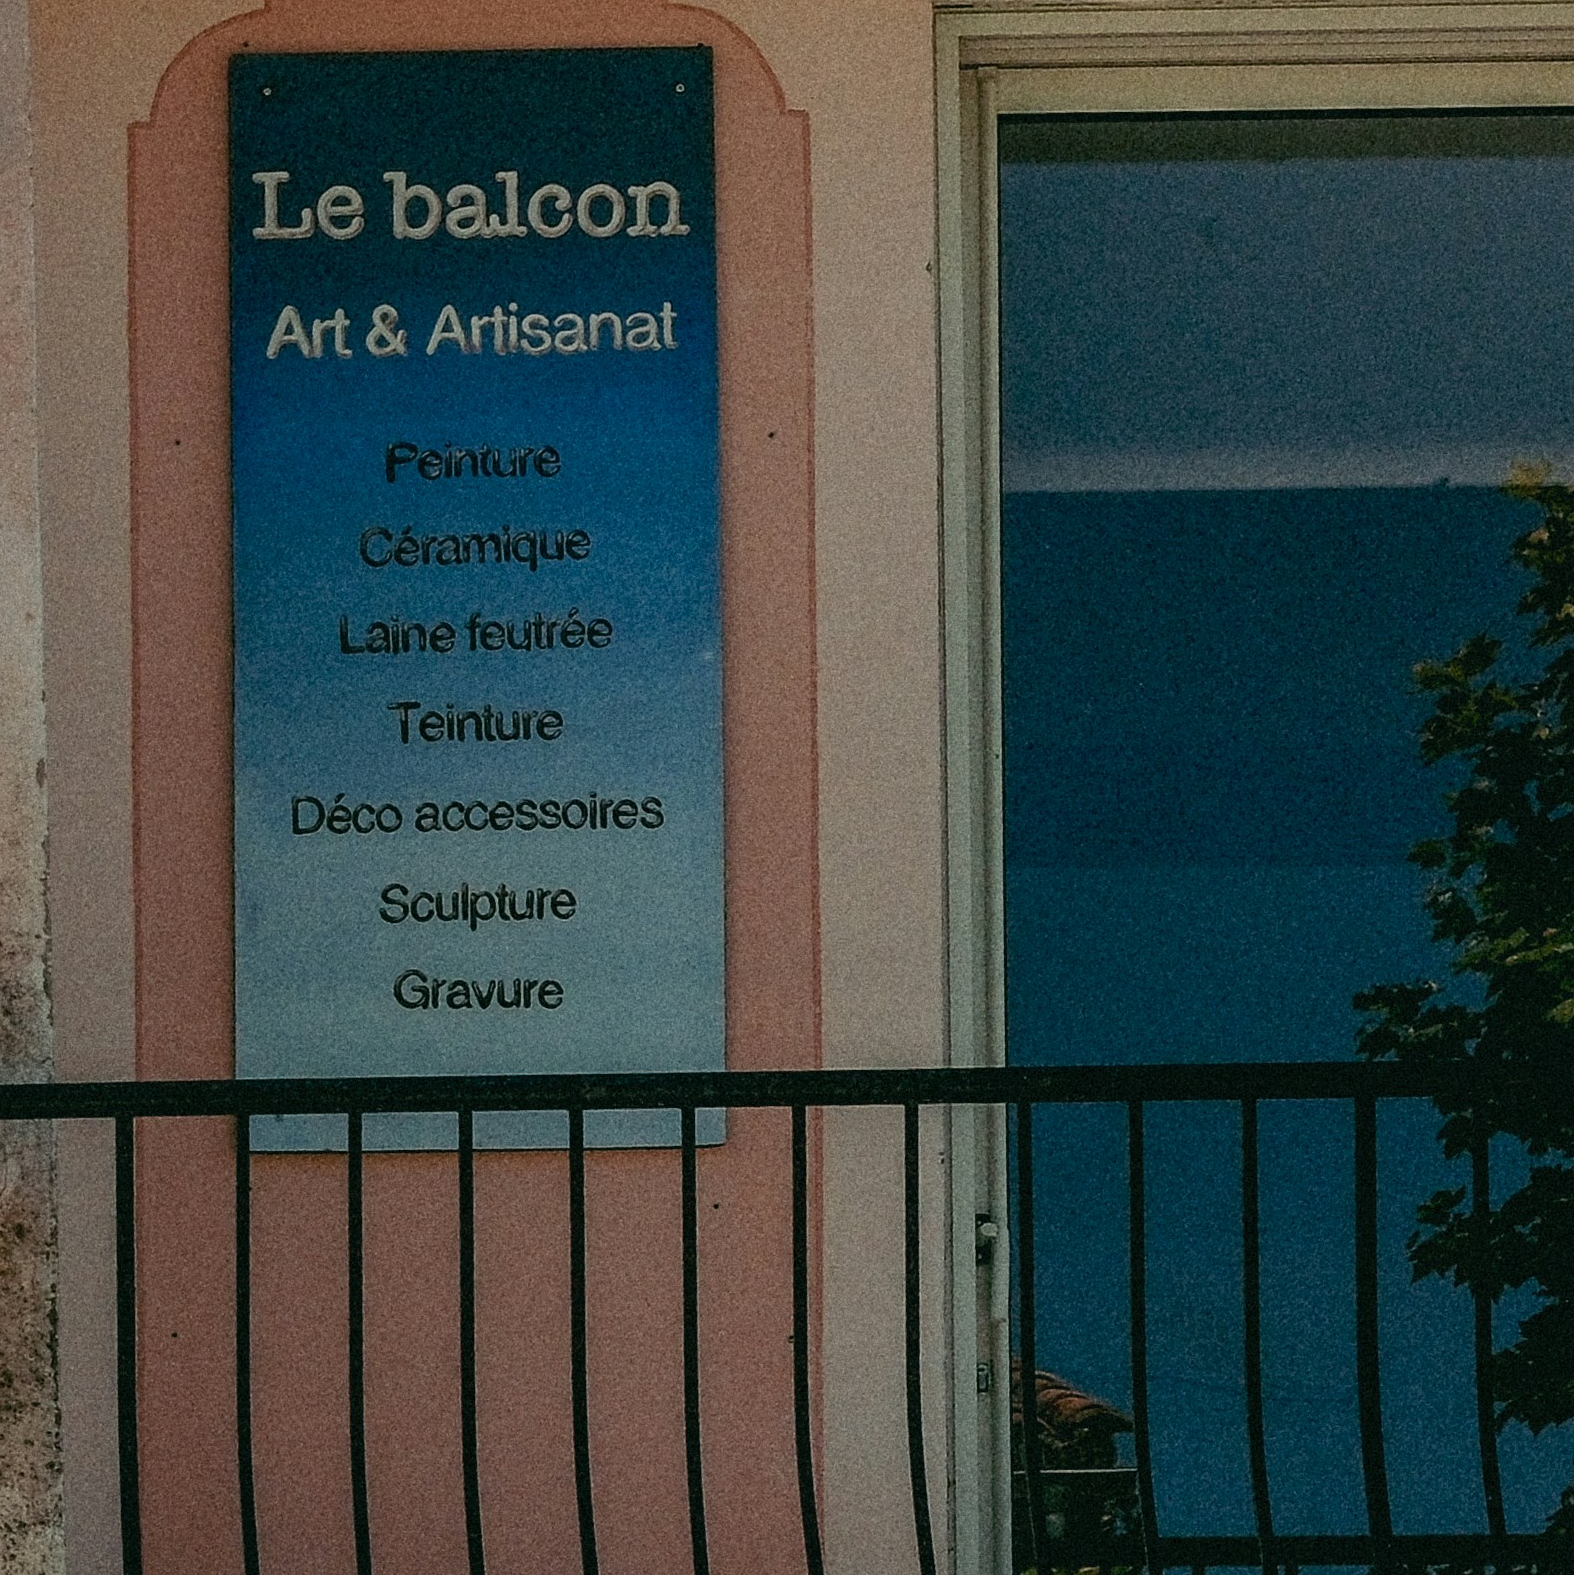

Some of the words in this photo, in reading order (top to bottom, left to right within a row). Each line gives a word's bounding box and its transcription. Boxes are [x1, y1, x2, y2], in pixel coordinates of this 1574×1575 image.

[252, 171, 364, 241] Le
[384, 169, 691, 240] balcon
[265, 304, 352, 359] Art
[365, 303, 406, 356] &
[426, 301, 679, 356] Artisanat
[385, 440, 562, 483] Peinture
[358, 519, 592, 571] Céramique
[338, 613, 457, 657] Laine
[467, 606, 614, 652] feutrée
[388, 701, 564, 746] Teinture
[290, 792, 403, 835] Déco
[414, 790, 666, 833] accessoires
[379, 882, 577, 932] Sculpture
[392, 969, 565, 1011] Gravure
